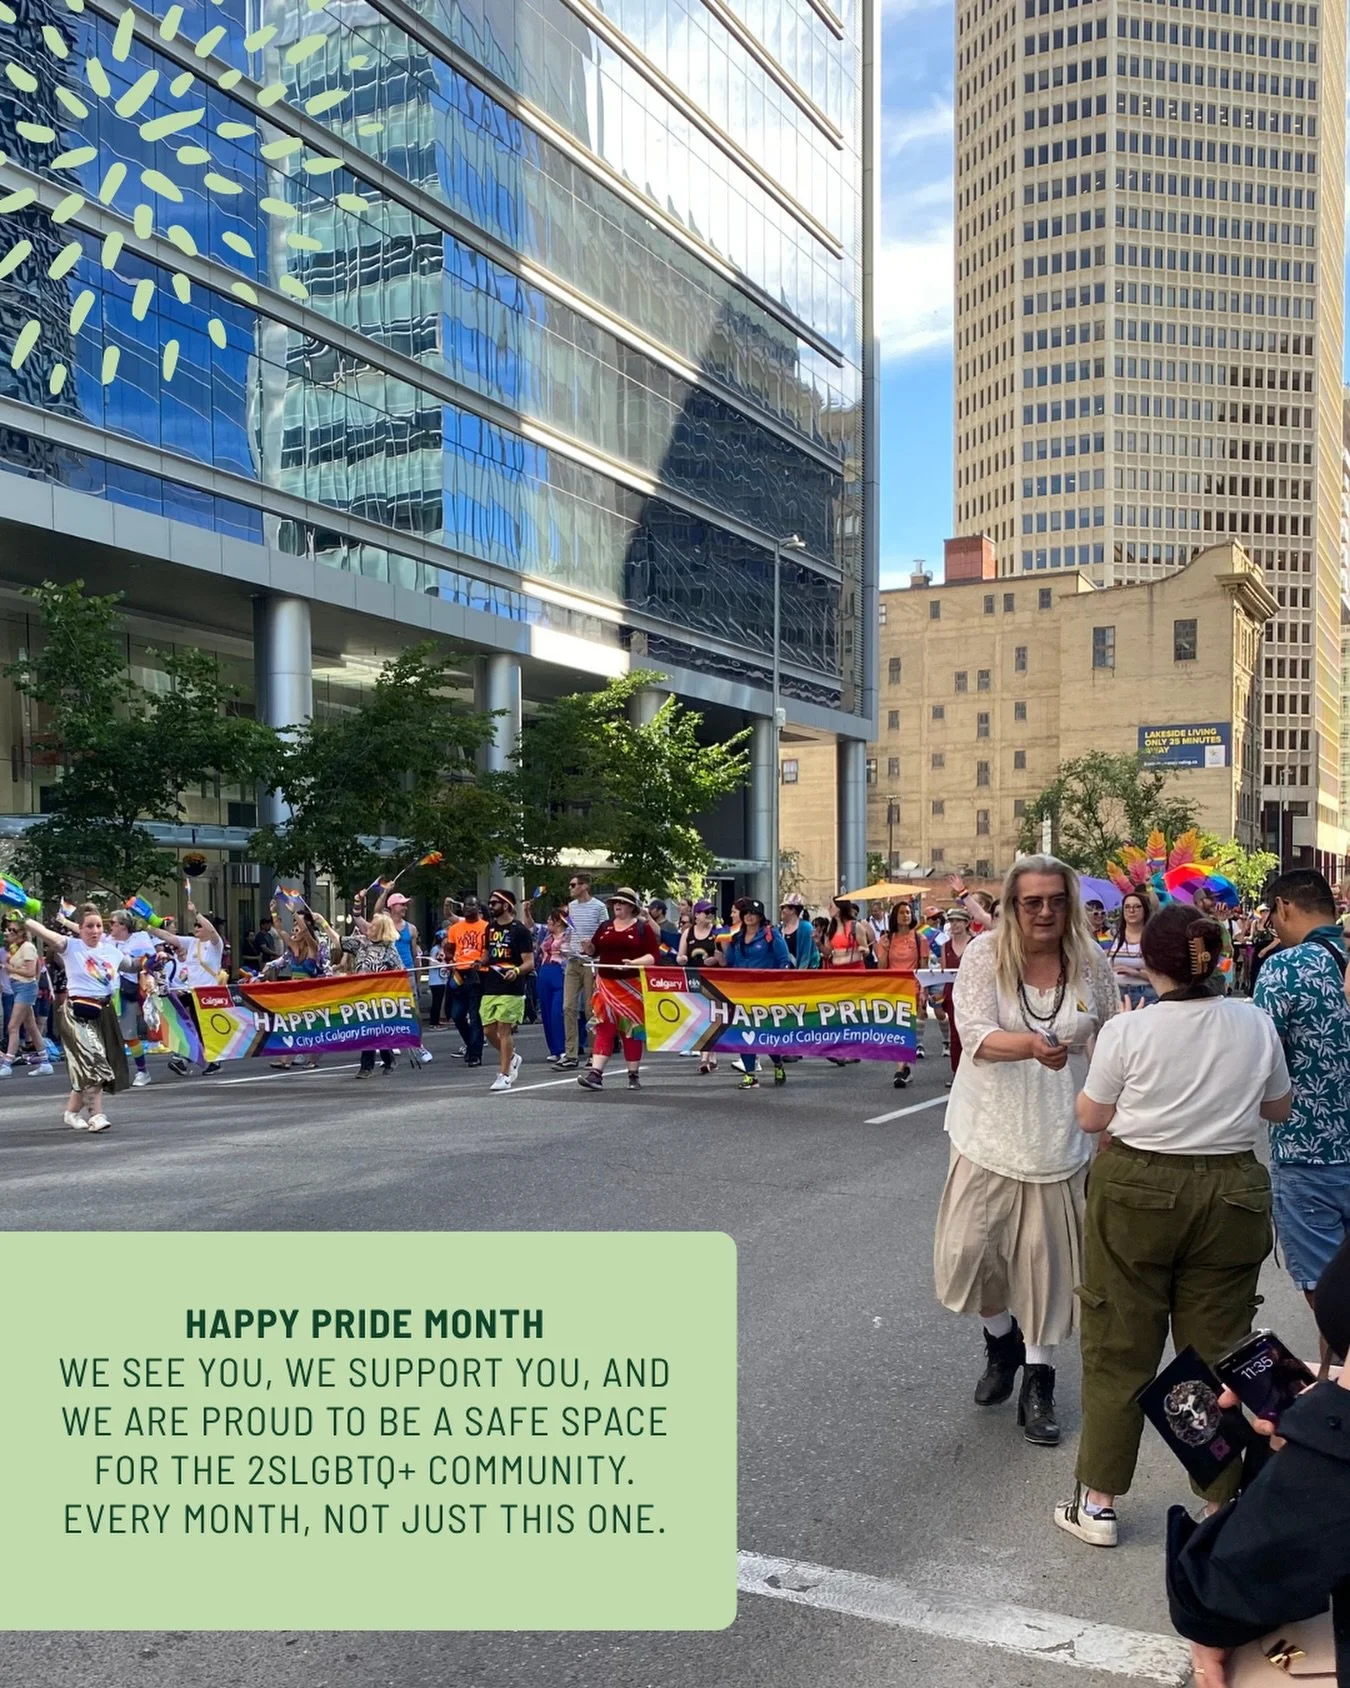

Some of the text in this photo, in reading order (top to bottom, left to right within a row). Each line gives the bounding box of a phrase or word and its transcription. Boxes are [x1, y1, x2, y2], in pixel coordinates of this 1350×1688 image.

[1144, 728, 1217, 738] LAKESIDE LIVING
[1169, 738, 1180, 746] 25
[1181, 736, 1221, 744] MINUTES
[491, 947, 512, 958] OVE
[650, 978, 683, 990] Calgary
[201, 997, 229, 1006] Calgary
[253, 998, 413, 1033] HAPPY PRIDE
[710, 999, 912, 1028] HAPPY PRIDE
[296, 1023, 411, 1048] City of Calgary Employees
[759, 1028, 906, 1047] City of Calgary Employees
[1240, 1355, 1274, 1380] 11:35
